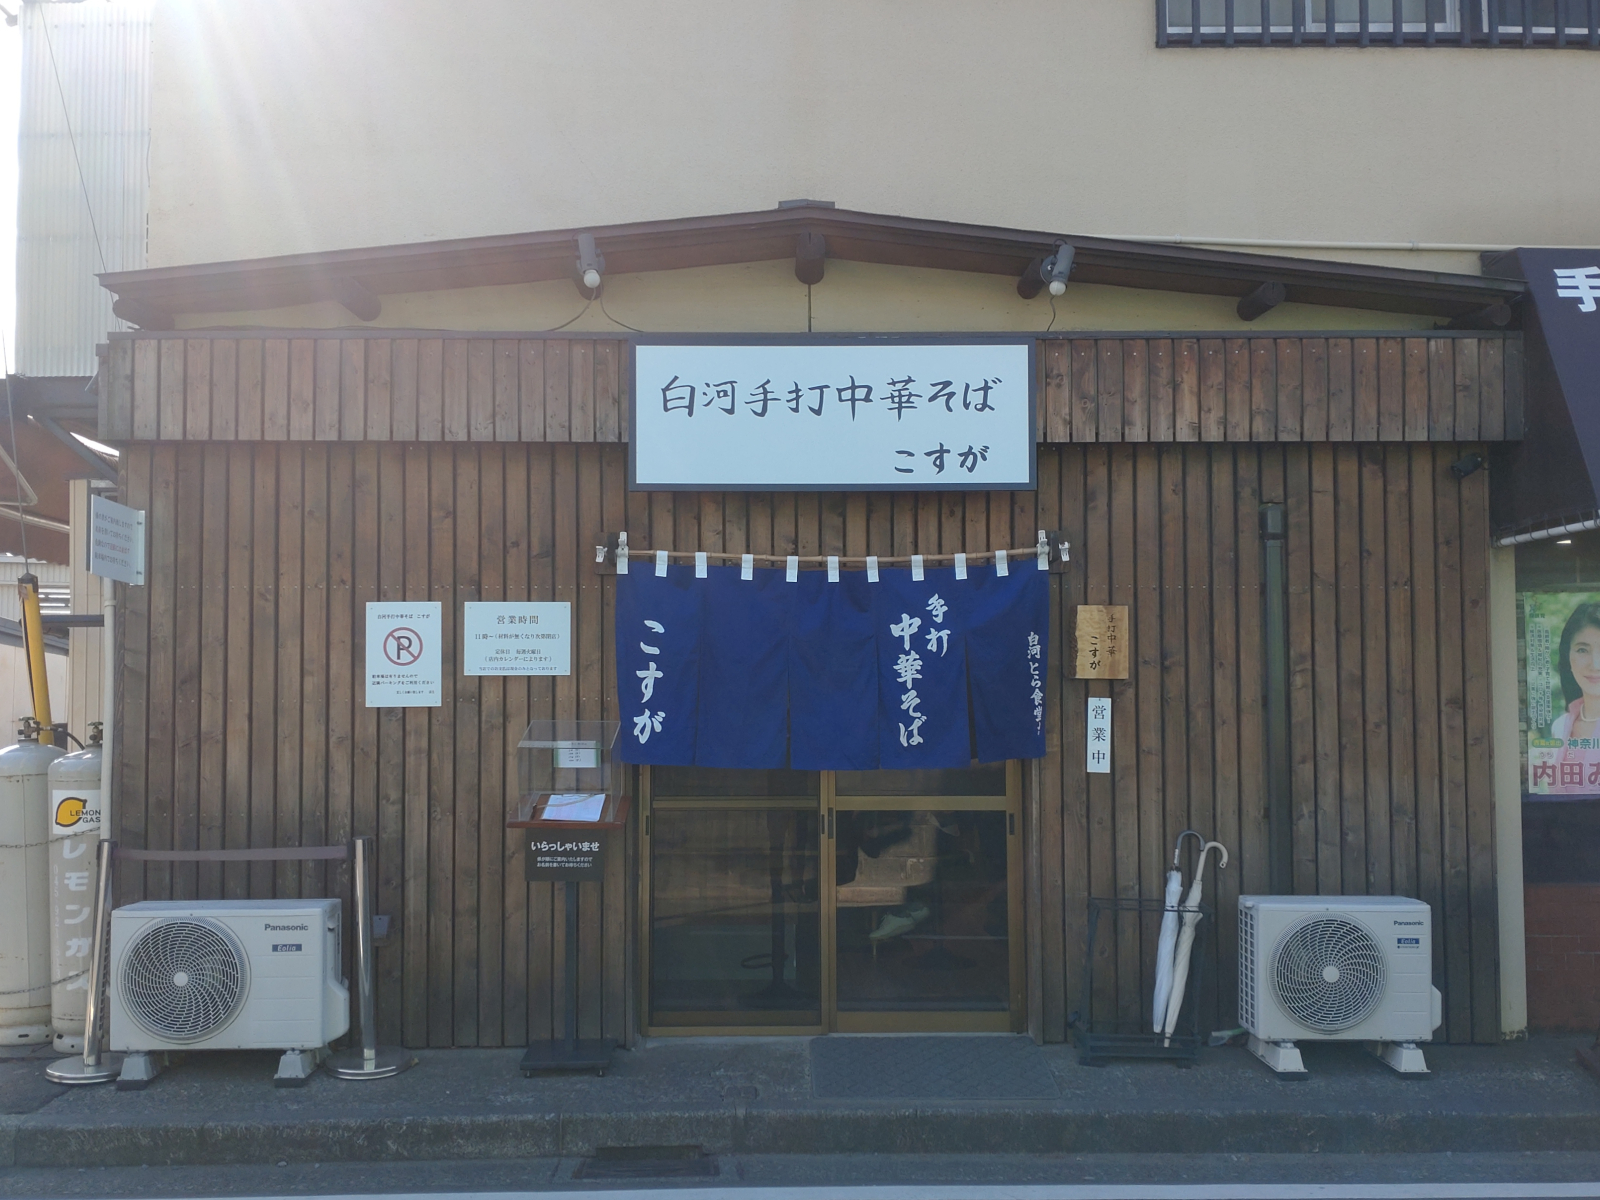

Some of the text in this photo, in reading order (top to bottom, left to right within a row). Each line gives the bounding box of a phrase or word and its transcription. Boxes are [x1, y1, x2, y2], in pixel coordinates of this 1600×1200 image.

[1553, 266, 1600, 312] 手
[661, 375, 1003, 422] 白河手打中華そば
[894, 442, 990, 475] こすが
[496, 615, 539, 625] 営業時間
[925, 593, 951, 657] 手打
[1088, 635, 1101, 671] こすが
[633, 619, 666, 744] こすが
[889, 613, 927, 747] 中華そば
[1092, 705, 1107, 765] 営業中
[70, 809, 101, 817] LEMON
[82, 816, 101, 824] GAS
[531, 841, 600, 851] いらっしゃいませ
[63, 839, 92, 991] レモンガス
[264, 923, 309, 931] Panasonic
[277, 944, 297, 952] Eolia
